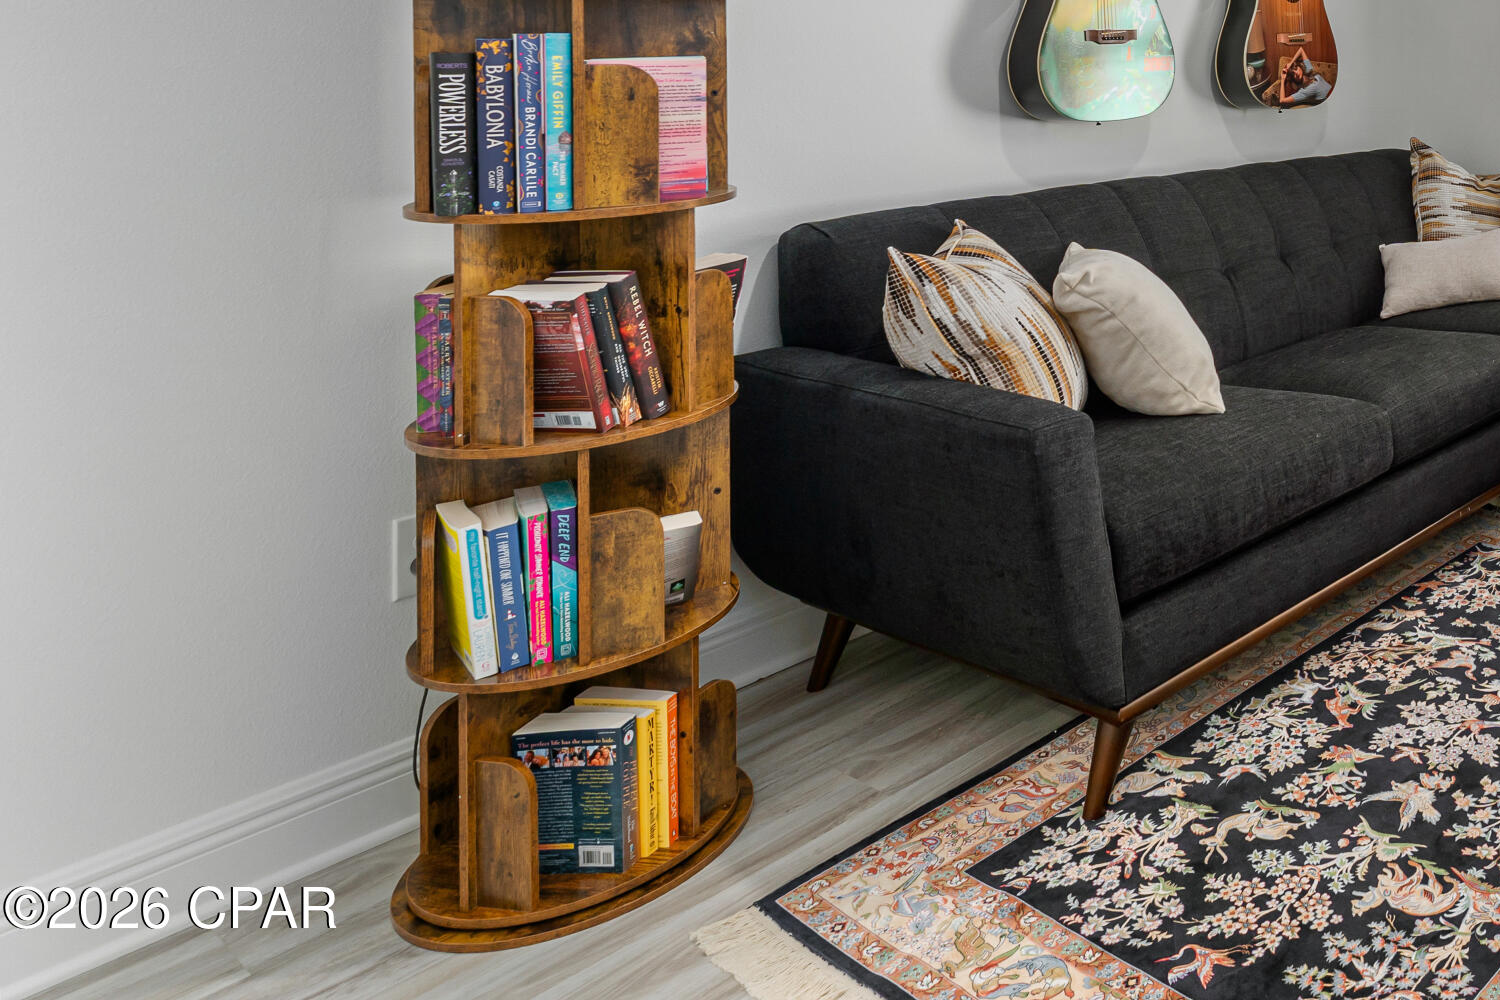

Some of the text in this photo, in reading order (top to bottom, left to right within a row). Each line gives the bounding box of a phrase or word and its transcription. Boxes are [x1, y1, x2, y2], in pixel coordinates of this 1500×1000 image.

[438, 73, 467, 154] POWERLESS
[486, 65, 504, 149] BABYLONIA
[552, 55, 565, 128] EMILY GIFFIN
[525, 107, 538, 198] BRANDI CARLILE
[552, 161, 560, 176] PACT
[560, 162, 568, 186] SUMMER
[488, 170, 496, 189] CASATI
[496, 165, 504, 193] COSTANZA
[629, 286, 653, 357] REBEL WITCH
[648, 366, 659, 395] CICCARELLI
[557, 514, 571, 563] DEEP END
[496, 532, 514, 606] IT HAPPENED ONE SUMMER
[534, 553, 543, 576] SUMMER
[564, 602, 572, 642] HAZELWOOD
[530, 741, 549, 749] perfect
[669, 739, 677, 768] BOYS
[623, 760, 631, 809] COUPLE
[630, 759, 638, 811] PERFECT
